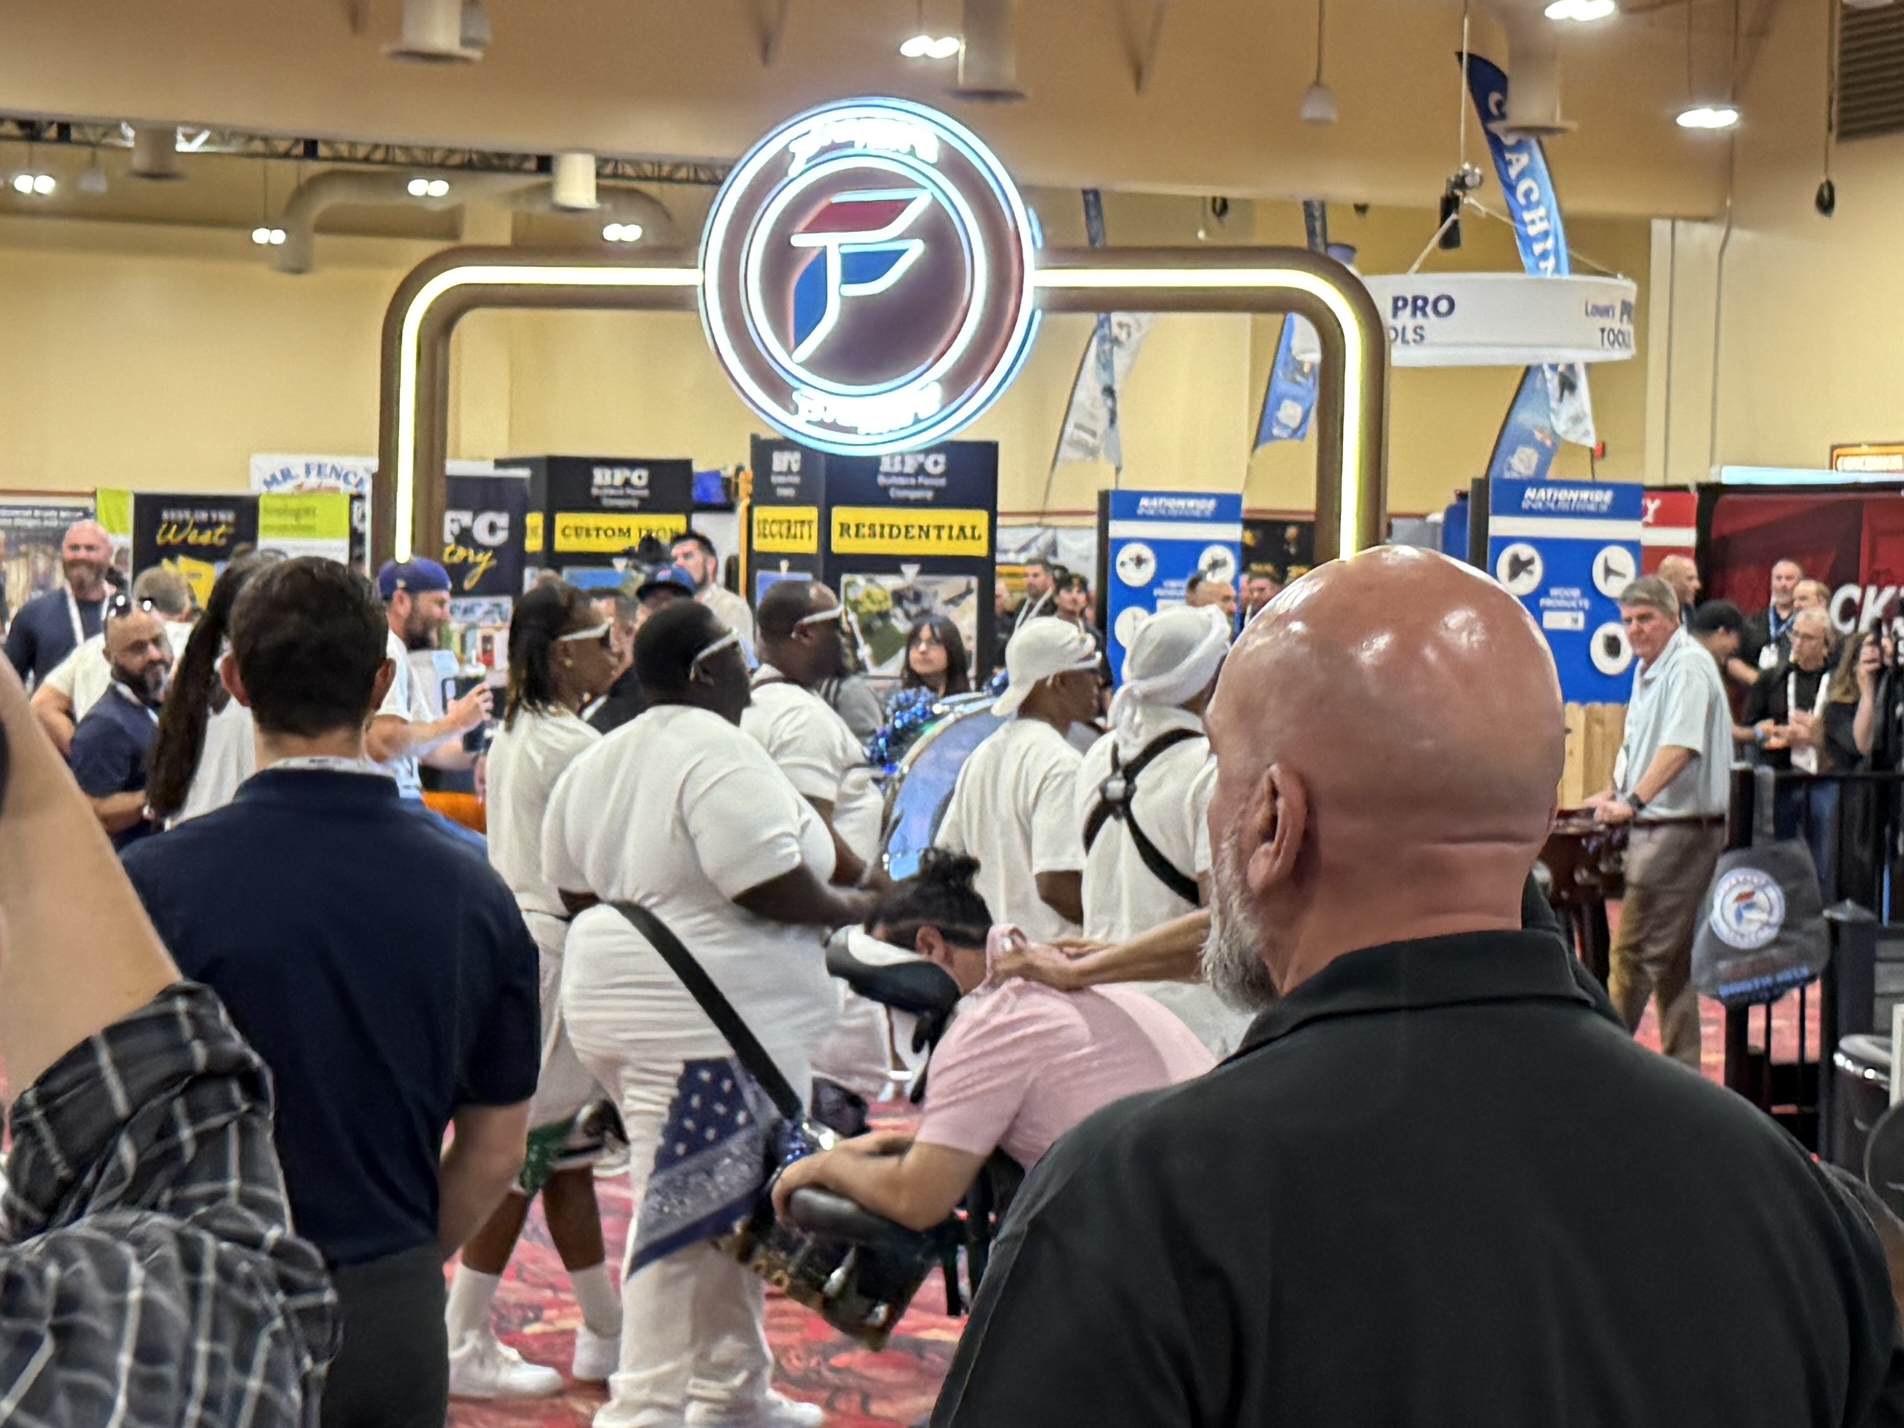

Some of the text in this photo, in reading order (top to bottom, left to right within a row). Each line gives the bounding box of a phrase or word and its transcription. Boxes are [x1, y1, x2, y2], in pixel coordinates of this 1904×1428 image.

[1391, 293, 1456, 320] PRO
[1389, 325, 1426, 345] OLS
[1523, 487, 1614, 506] NATIONWIDE
[444, 511, 510, 546] FC
[561, 524, 632, 540] CUSTOM
[756, 519, 815, 542] SECURITY
[838, 522, 984, 542] RESIDENTIAL
